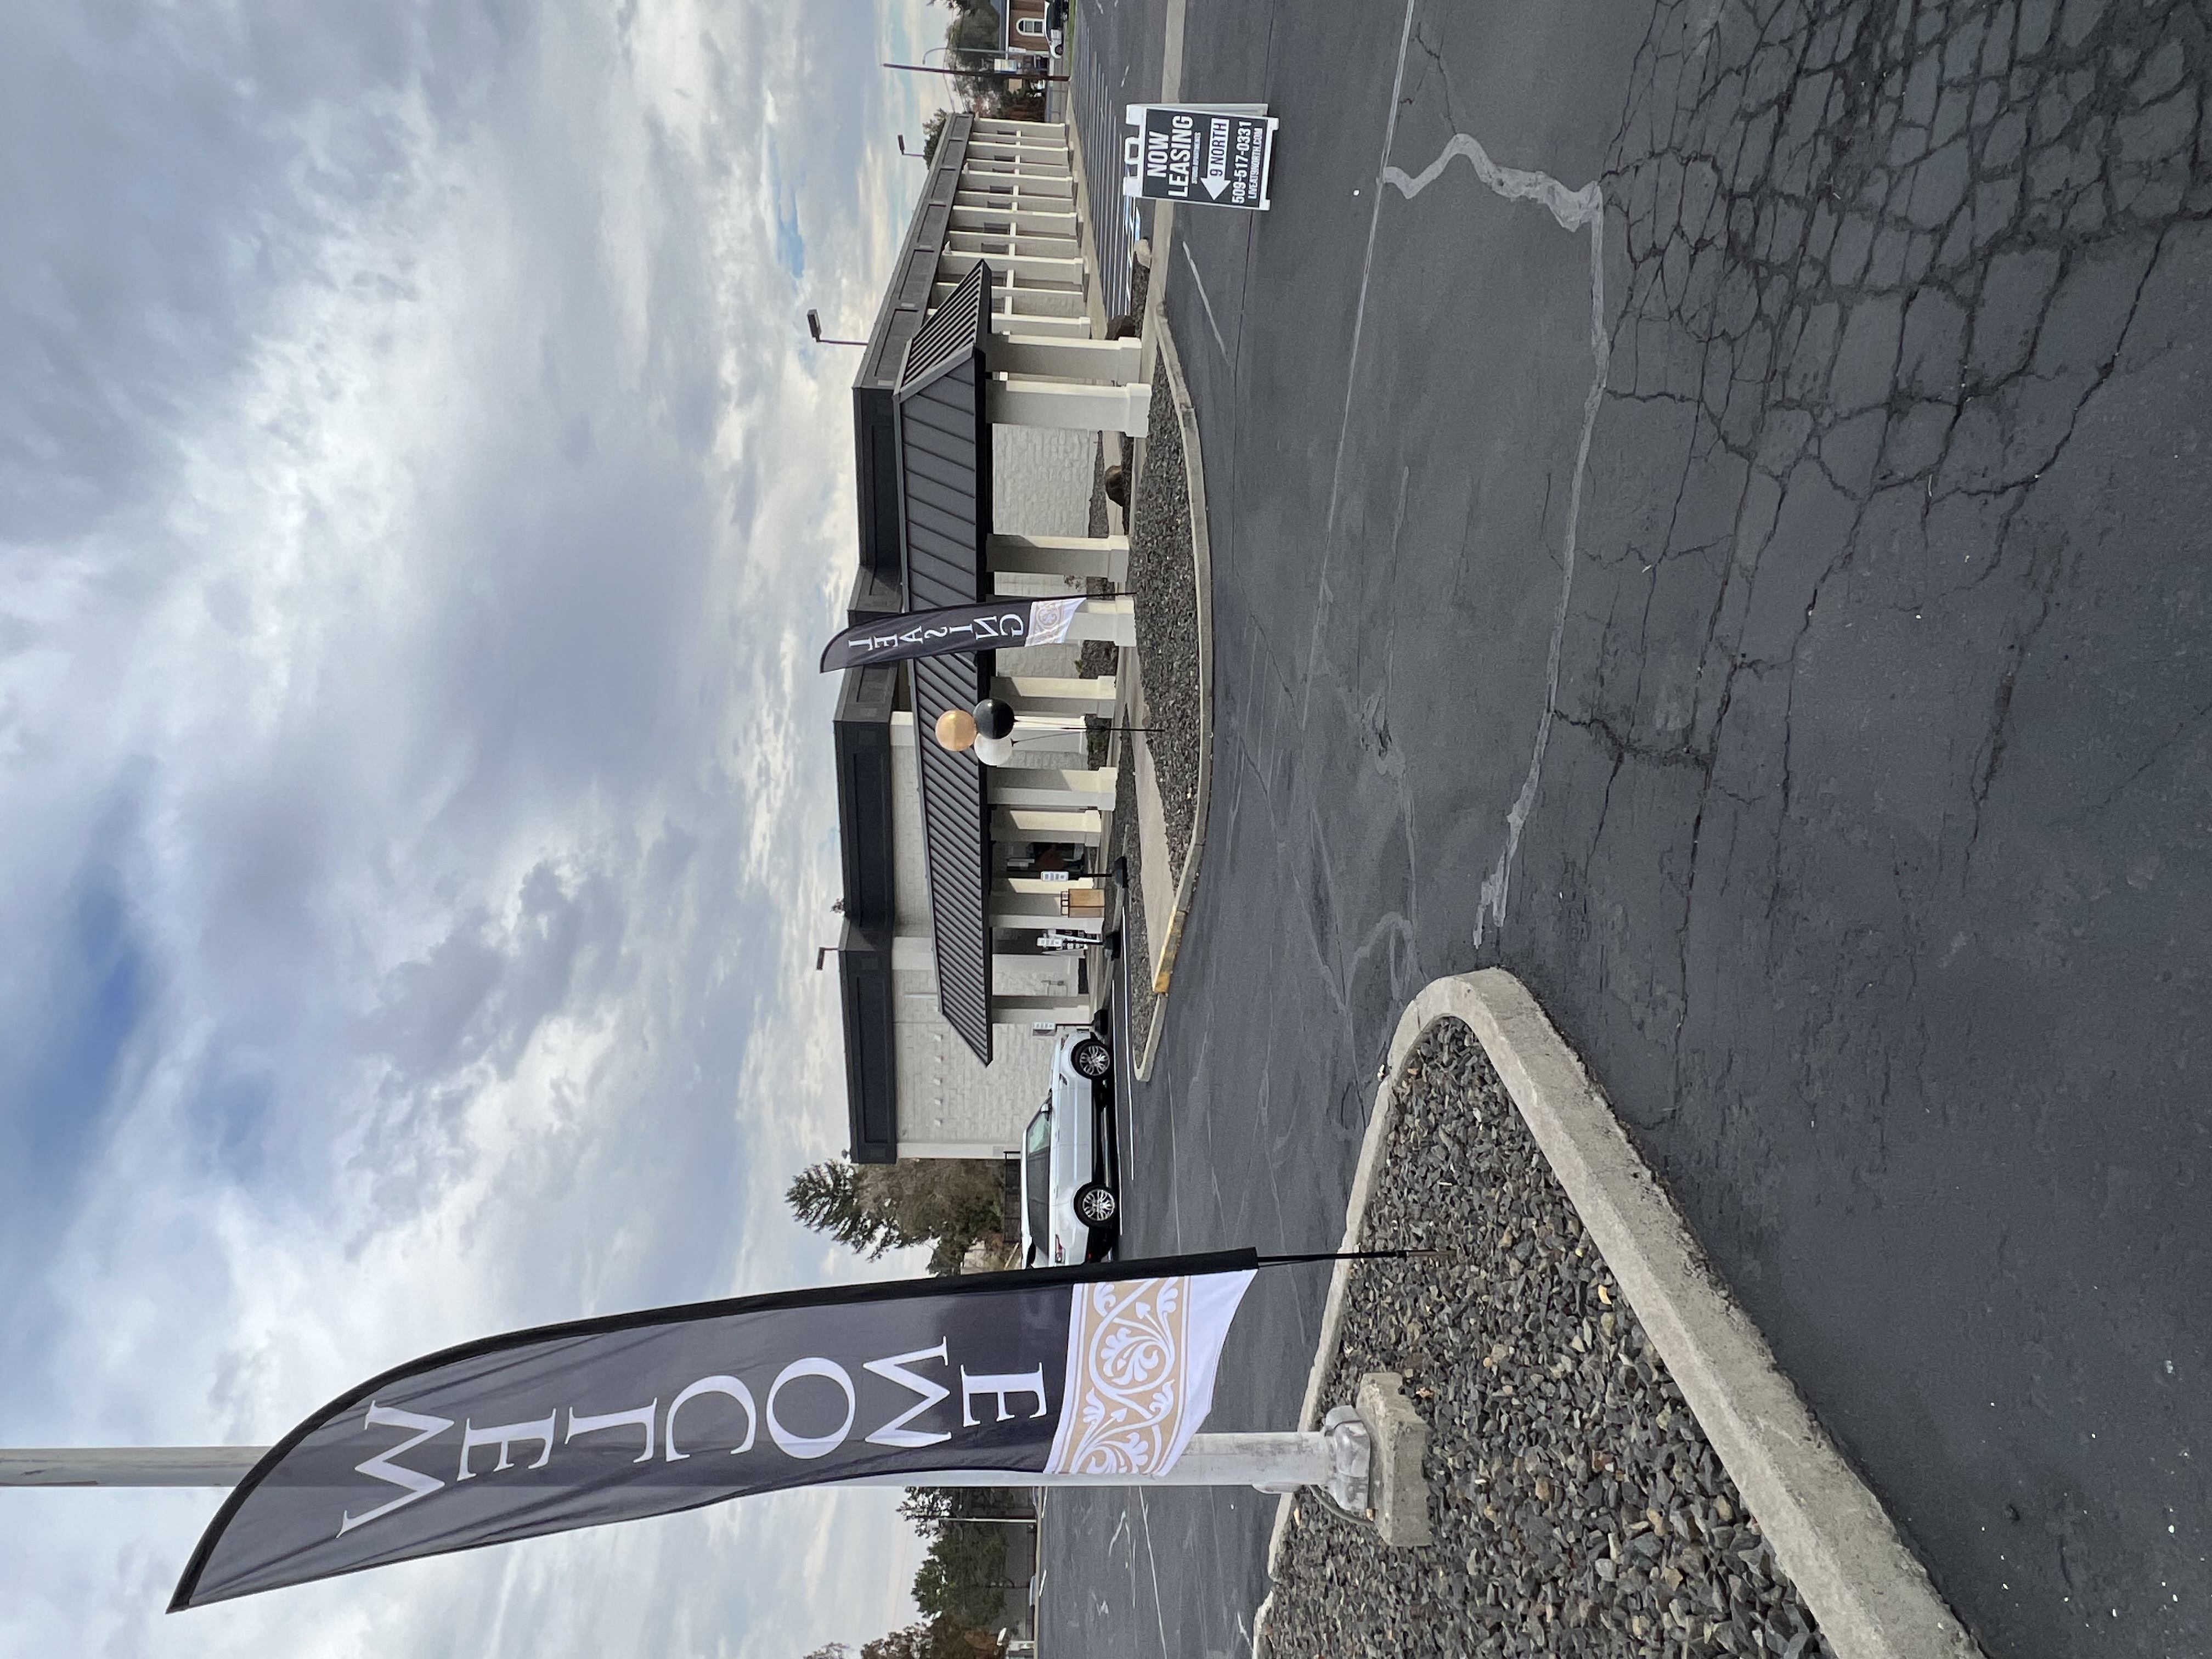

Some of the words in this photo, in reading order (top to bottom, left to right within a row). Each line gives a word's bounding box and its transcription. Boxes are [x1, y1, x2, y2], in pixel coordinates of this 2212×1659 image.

[1147, 131, 1169, 178] NOW
[1168, 115, 1193, 198] LEASING
[1210, 122, 1227, 167] NORTH
[1231, 121, 1252, 204] 509-517-0331
